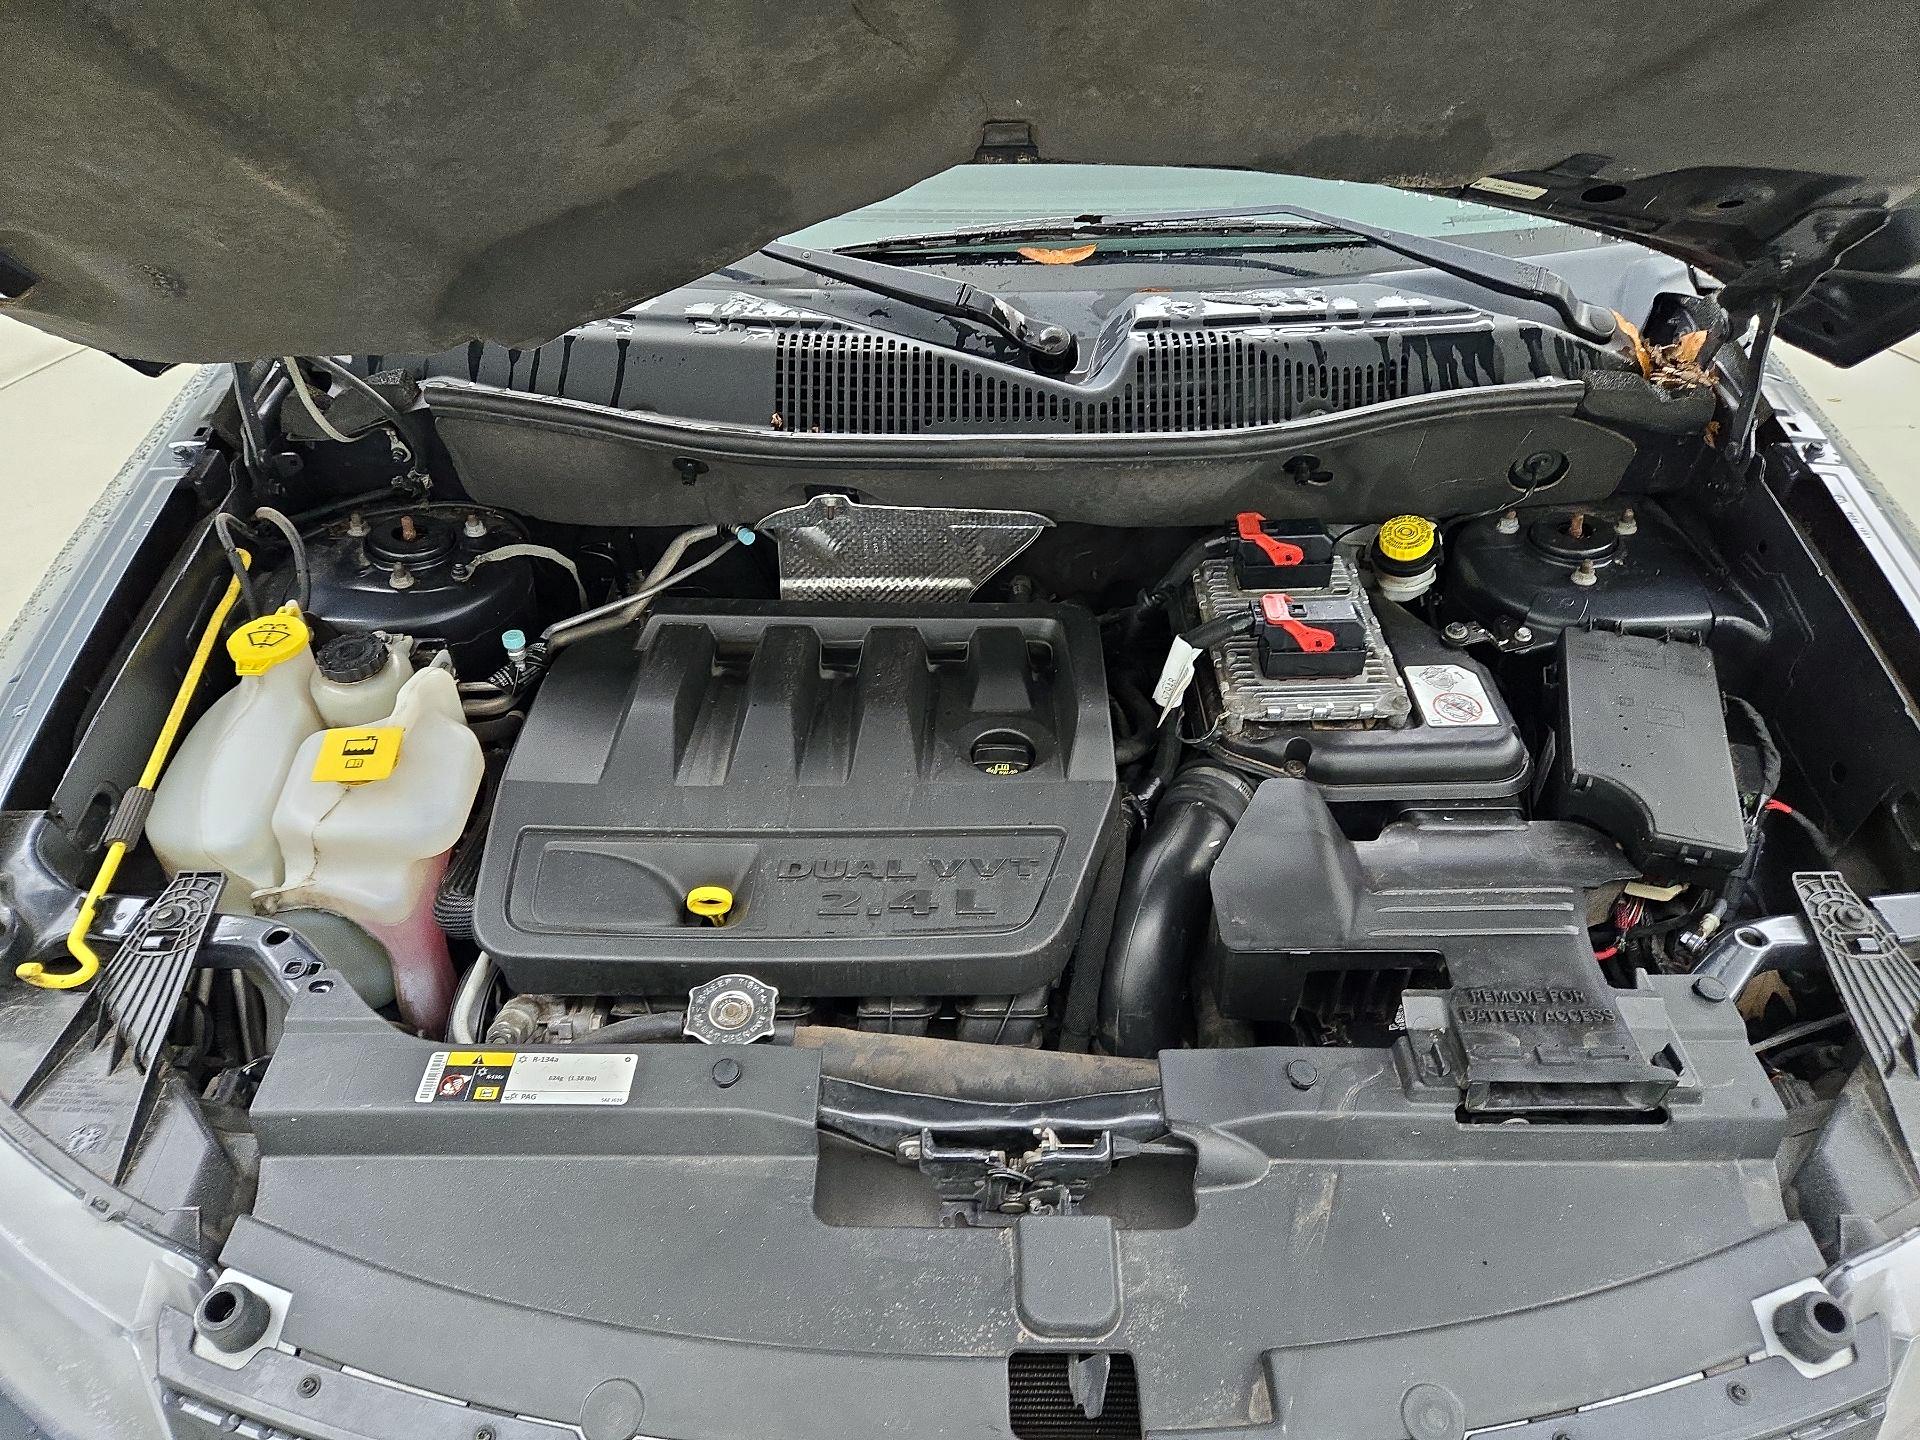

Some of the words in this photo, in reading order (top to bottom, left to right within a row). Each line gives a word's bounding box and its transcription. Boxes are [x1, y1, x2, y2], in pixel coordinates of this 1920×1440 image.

[777, 858, 917, 881] DUAL
[929, 857, 1041, 880] VVT
[1469, 989, 1544, 1004] REMOVE
[1548, 989, 1585, 1003] FOR
[1460, 1008, 1537, 1024] BATTERY
[1545, 1007, 1616, 1024] ACCESS
